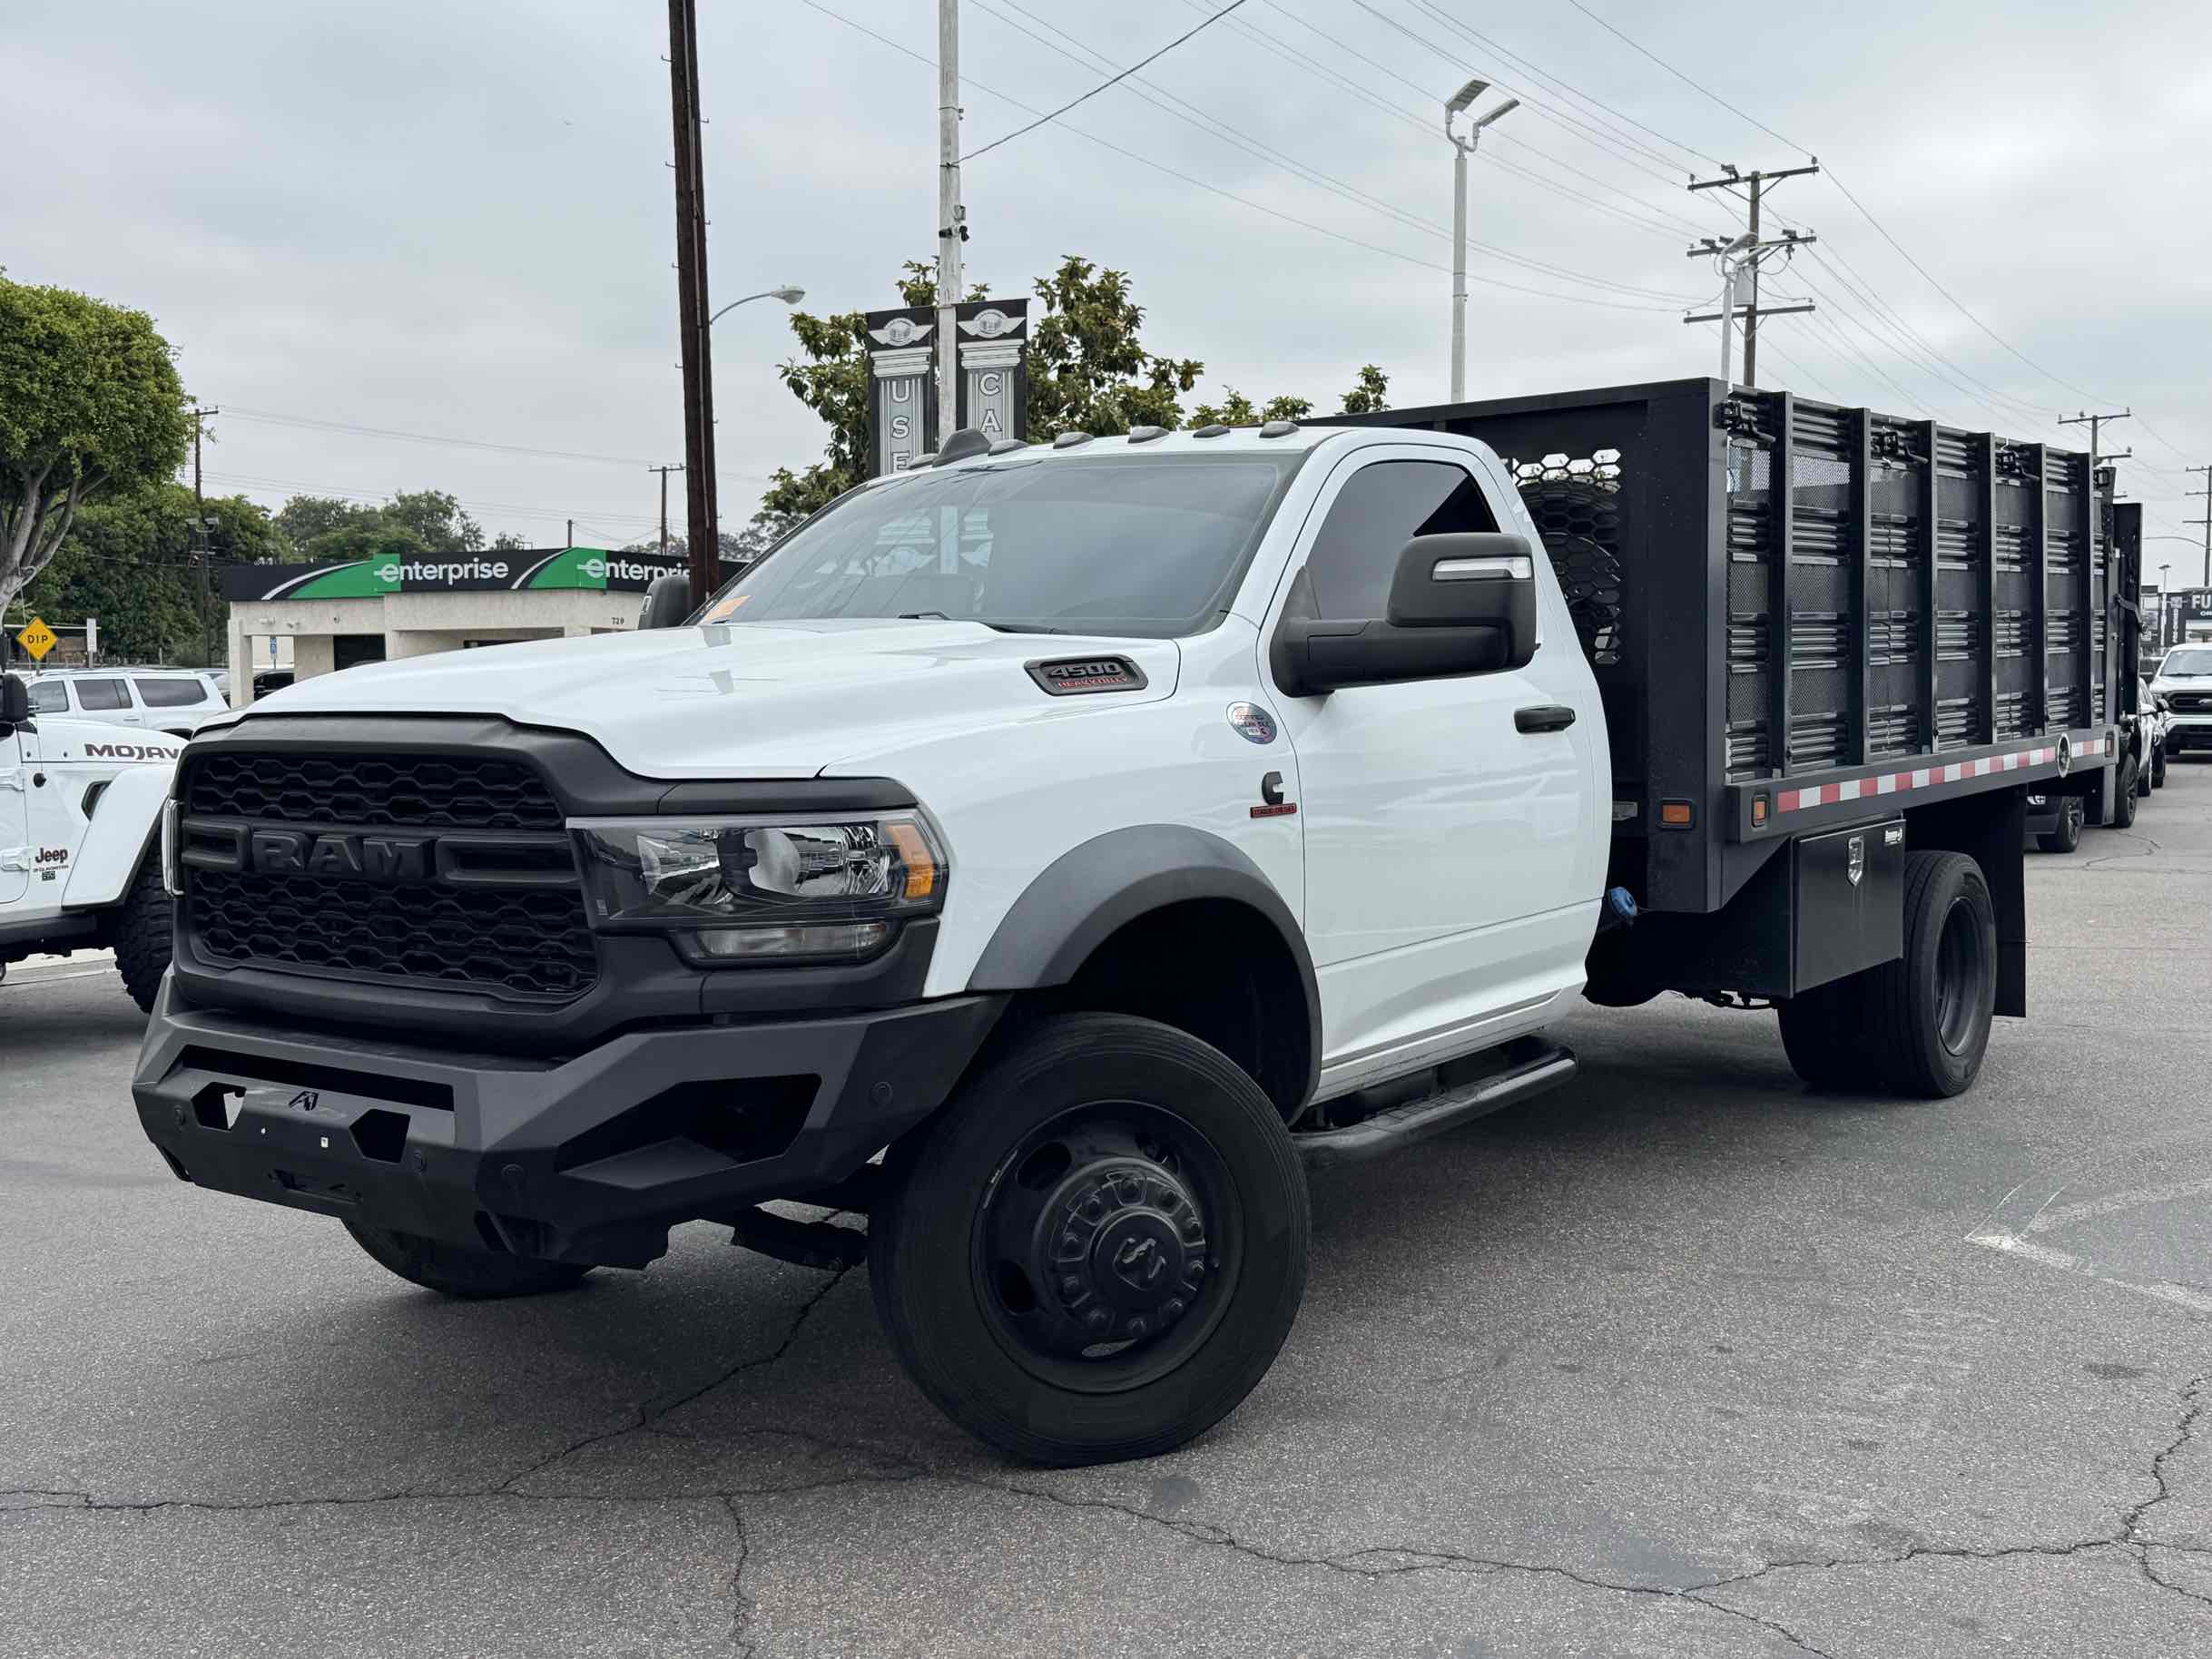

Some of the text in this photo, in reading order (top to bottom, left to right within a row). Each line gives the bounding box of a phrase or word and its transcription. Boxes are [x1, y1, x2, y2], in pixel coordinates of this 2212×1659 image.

[374, 557, 509, 585] enterprise
[27, 634, 48, 643] DIP
[1050, 661, 1120, 677] 4500
[35, 848, 68, 863] Jeep
[252, 831, 425, 876] RAM
